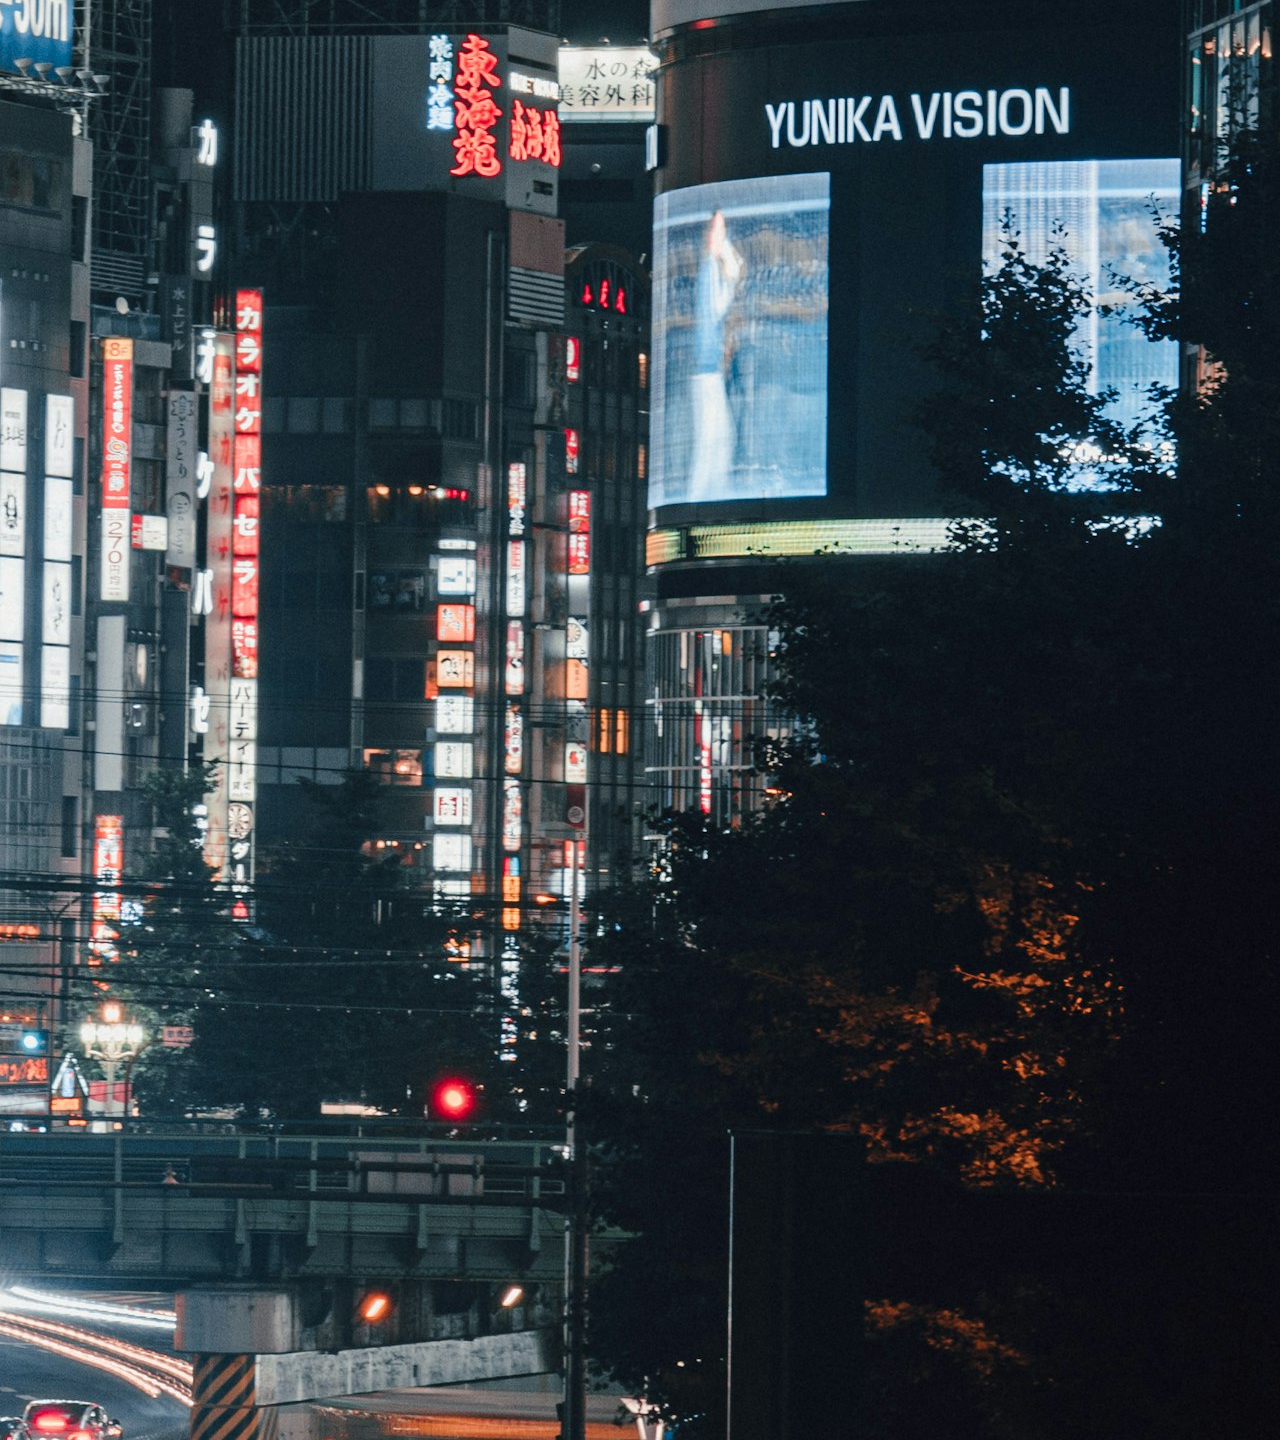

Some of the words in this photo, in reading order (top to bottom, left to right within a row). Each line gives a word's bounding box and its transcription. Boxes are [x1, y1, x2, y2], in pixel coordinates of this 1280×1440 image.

[586, 57, 654, 81] 水の森
[449, 33, 503, 178] 東海苑
[558, 84, 654, 108] 美容外科
[765, 96, 903, 149] YUNIKA
[911, 86, 1070, 141] VISION
